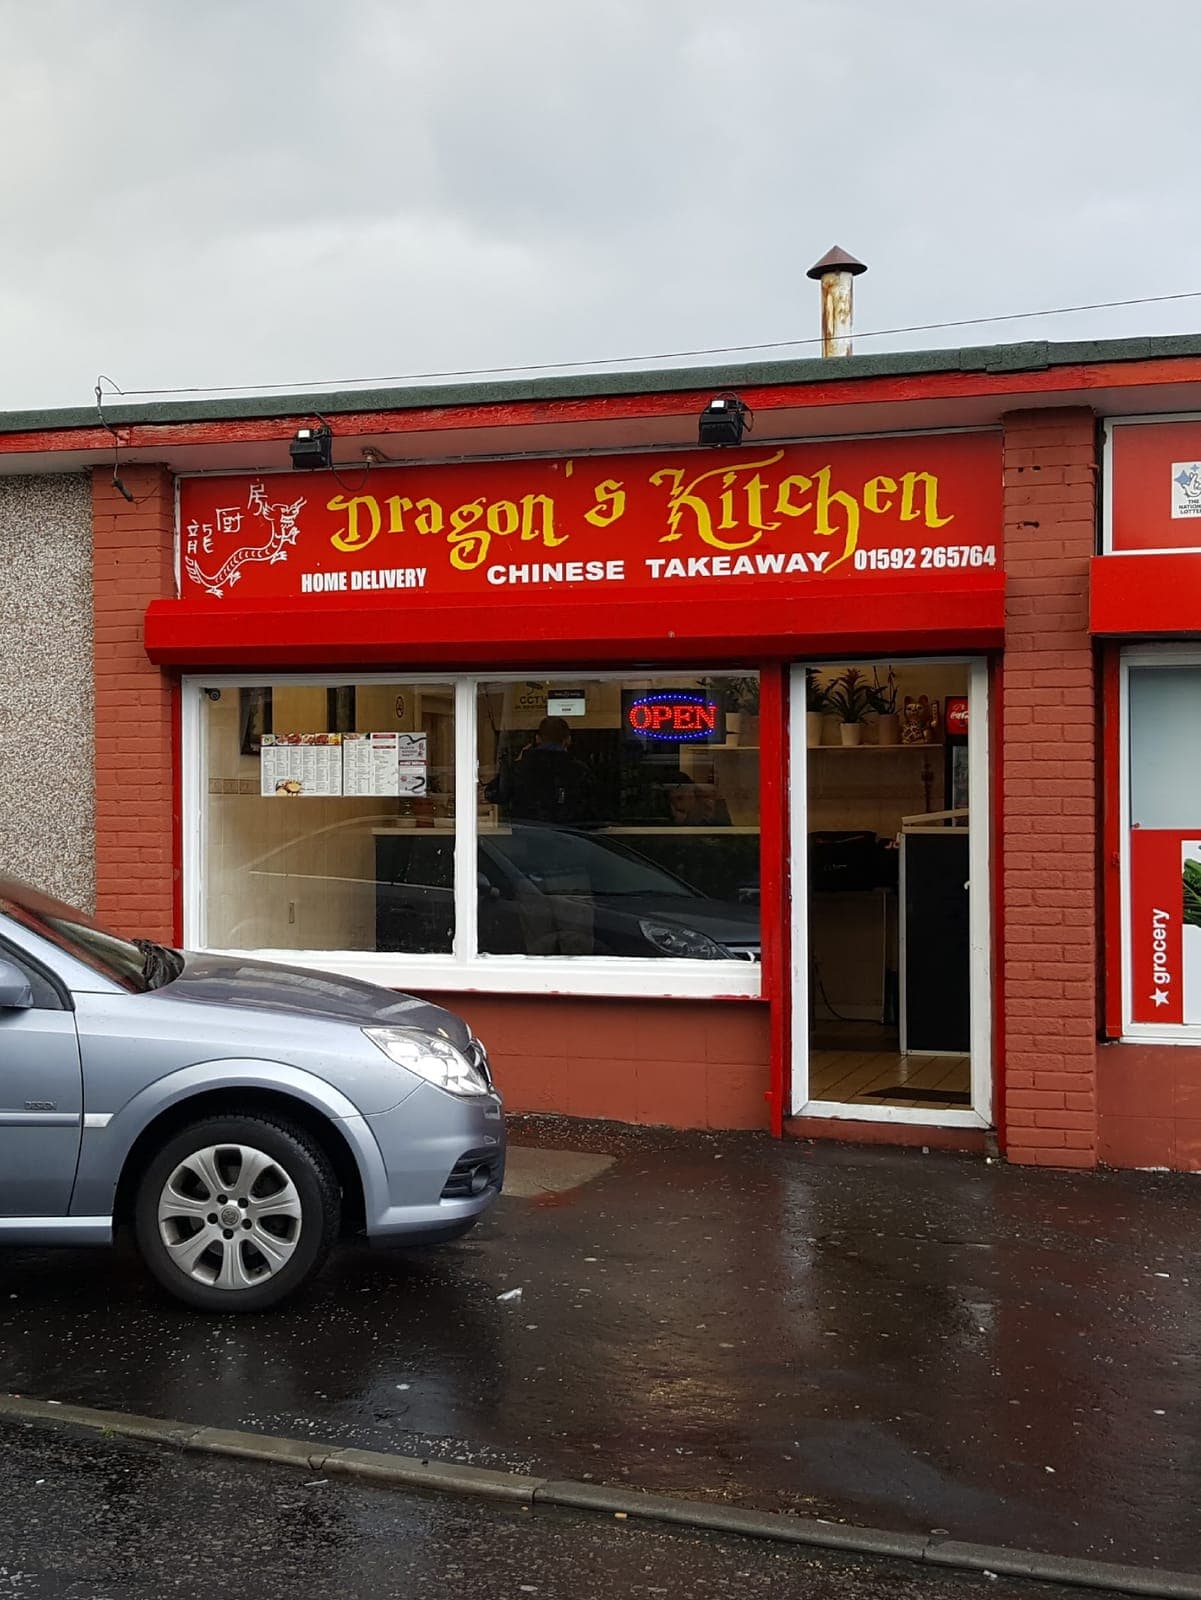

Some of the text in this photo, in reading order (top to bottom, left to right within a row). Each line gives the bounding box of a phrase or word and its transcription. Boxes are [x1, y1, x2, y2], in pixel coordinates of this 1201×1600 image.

[648, 449, 955, 573] Kitchen
[486, 551, 829, 585] CHINESE TAKEAWAY
[854, 545, 997, 571] 01592 265764
[301, 567, 427, 593] HOME DELIVERY
[629, 704, 717, 730] OPEN
[1152, 908, 1170, 985] grocery
